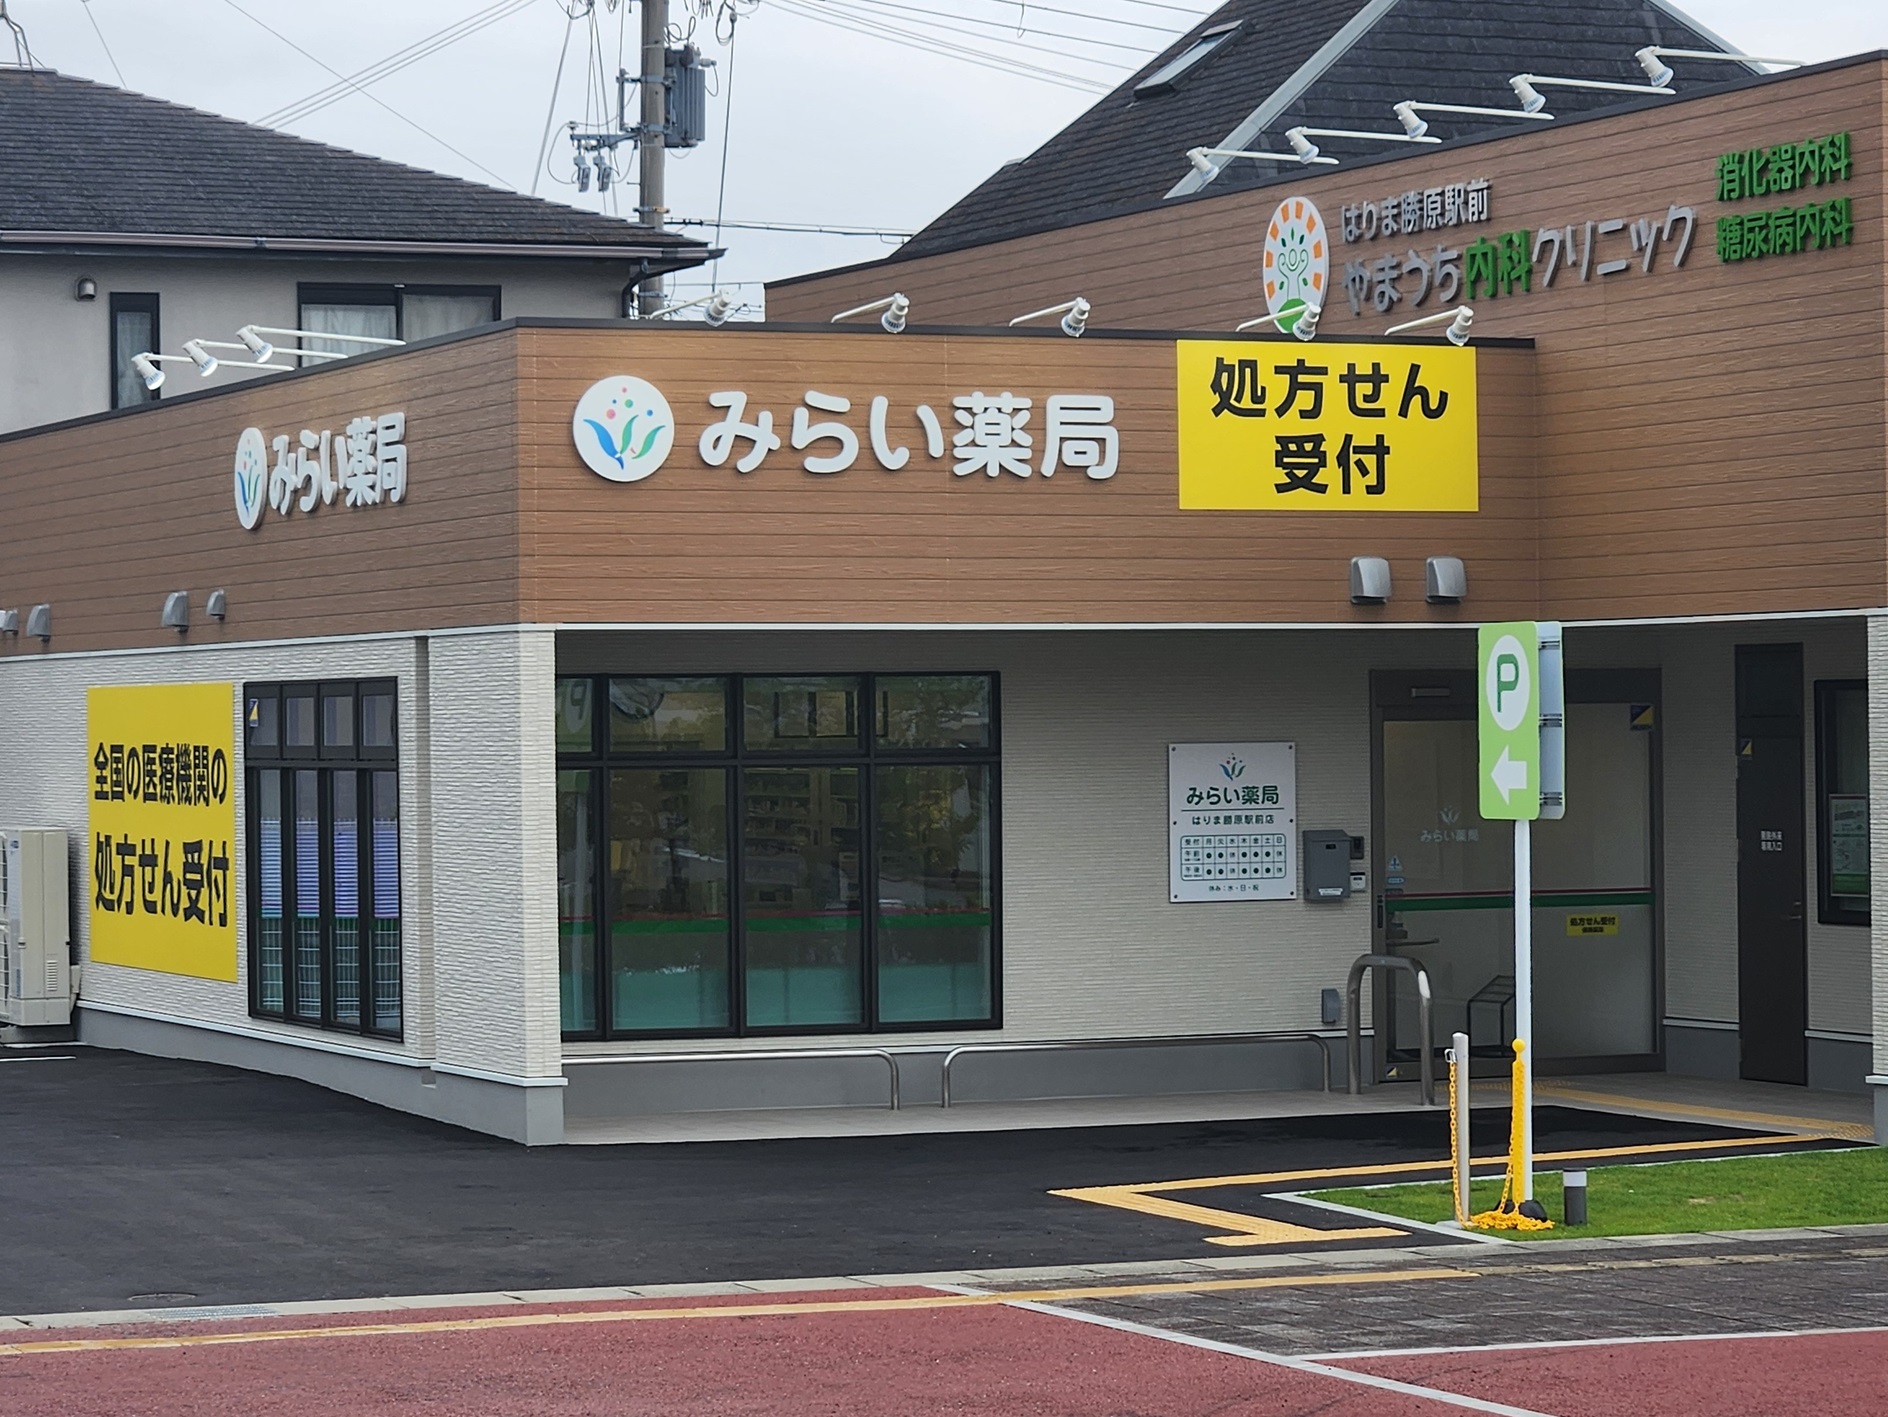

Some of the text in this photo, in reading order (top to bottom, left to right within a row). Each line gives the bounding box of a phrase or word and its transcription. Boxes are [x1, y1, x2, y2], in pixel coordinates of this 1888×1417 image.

[1715, 131, 1852, 200] 消化器内科
[1341, 177, 1490, 243] はりま勝原駅前
[1716, 197, 1853, 262] 糖尿病内科
[1341, 204, 1698, 315] やまうち内科クリニック
[1210, 356, 1449, 420] 処方せん
[268, 411, 408, 517] みらい薬局
[698, 390, 1121, 480] みらい薬局
[1273, 432, 1391, 496] 受付
[1496, 653, 1519, 713] P
[94, 742, 228, 807] 全国の医療機関の
[1186, 785, 1279, 806] みらい薬局
[1192, 814, 1274, 825] はりま勝原駅前店
[1420, 828, 1480, 843] みらい薬局
[94, 832, 230, 928] 処方せん受付
